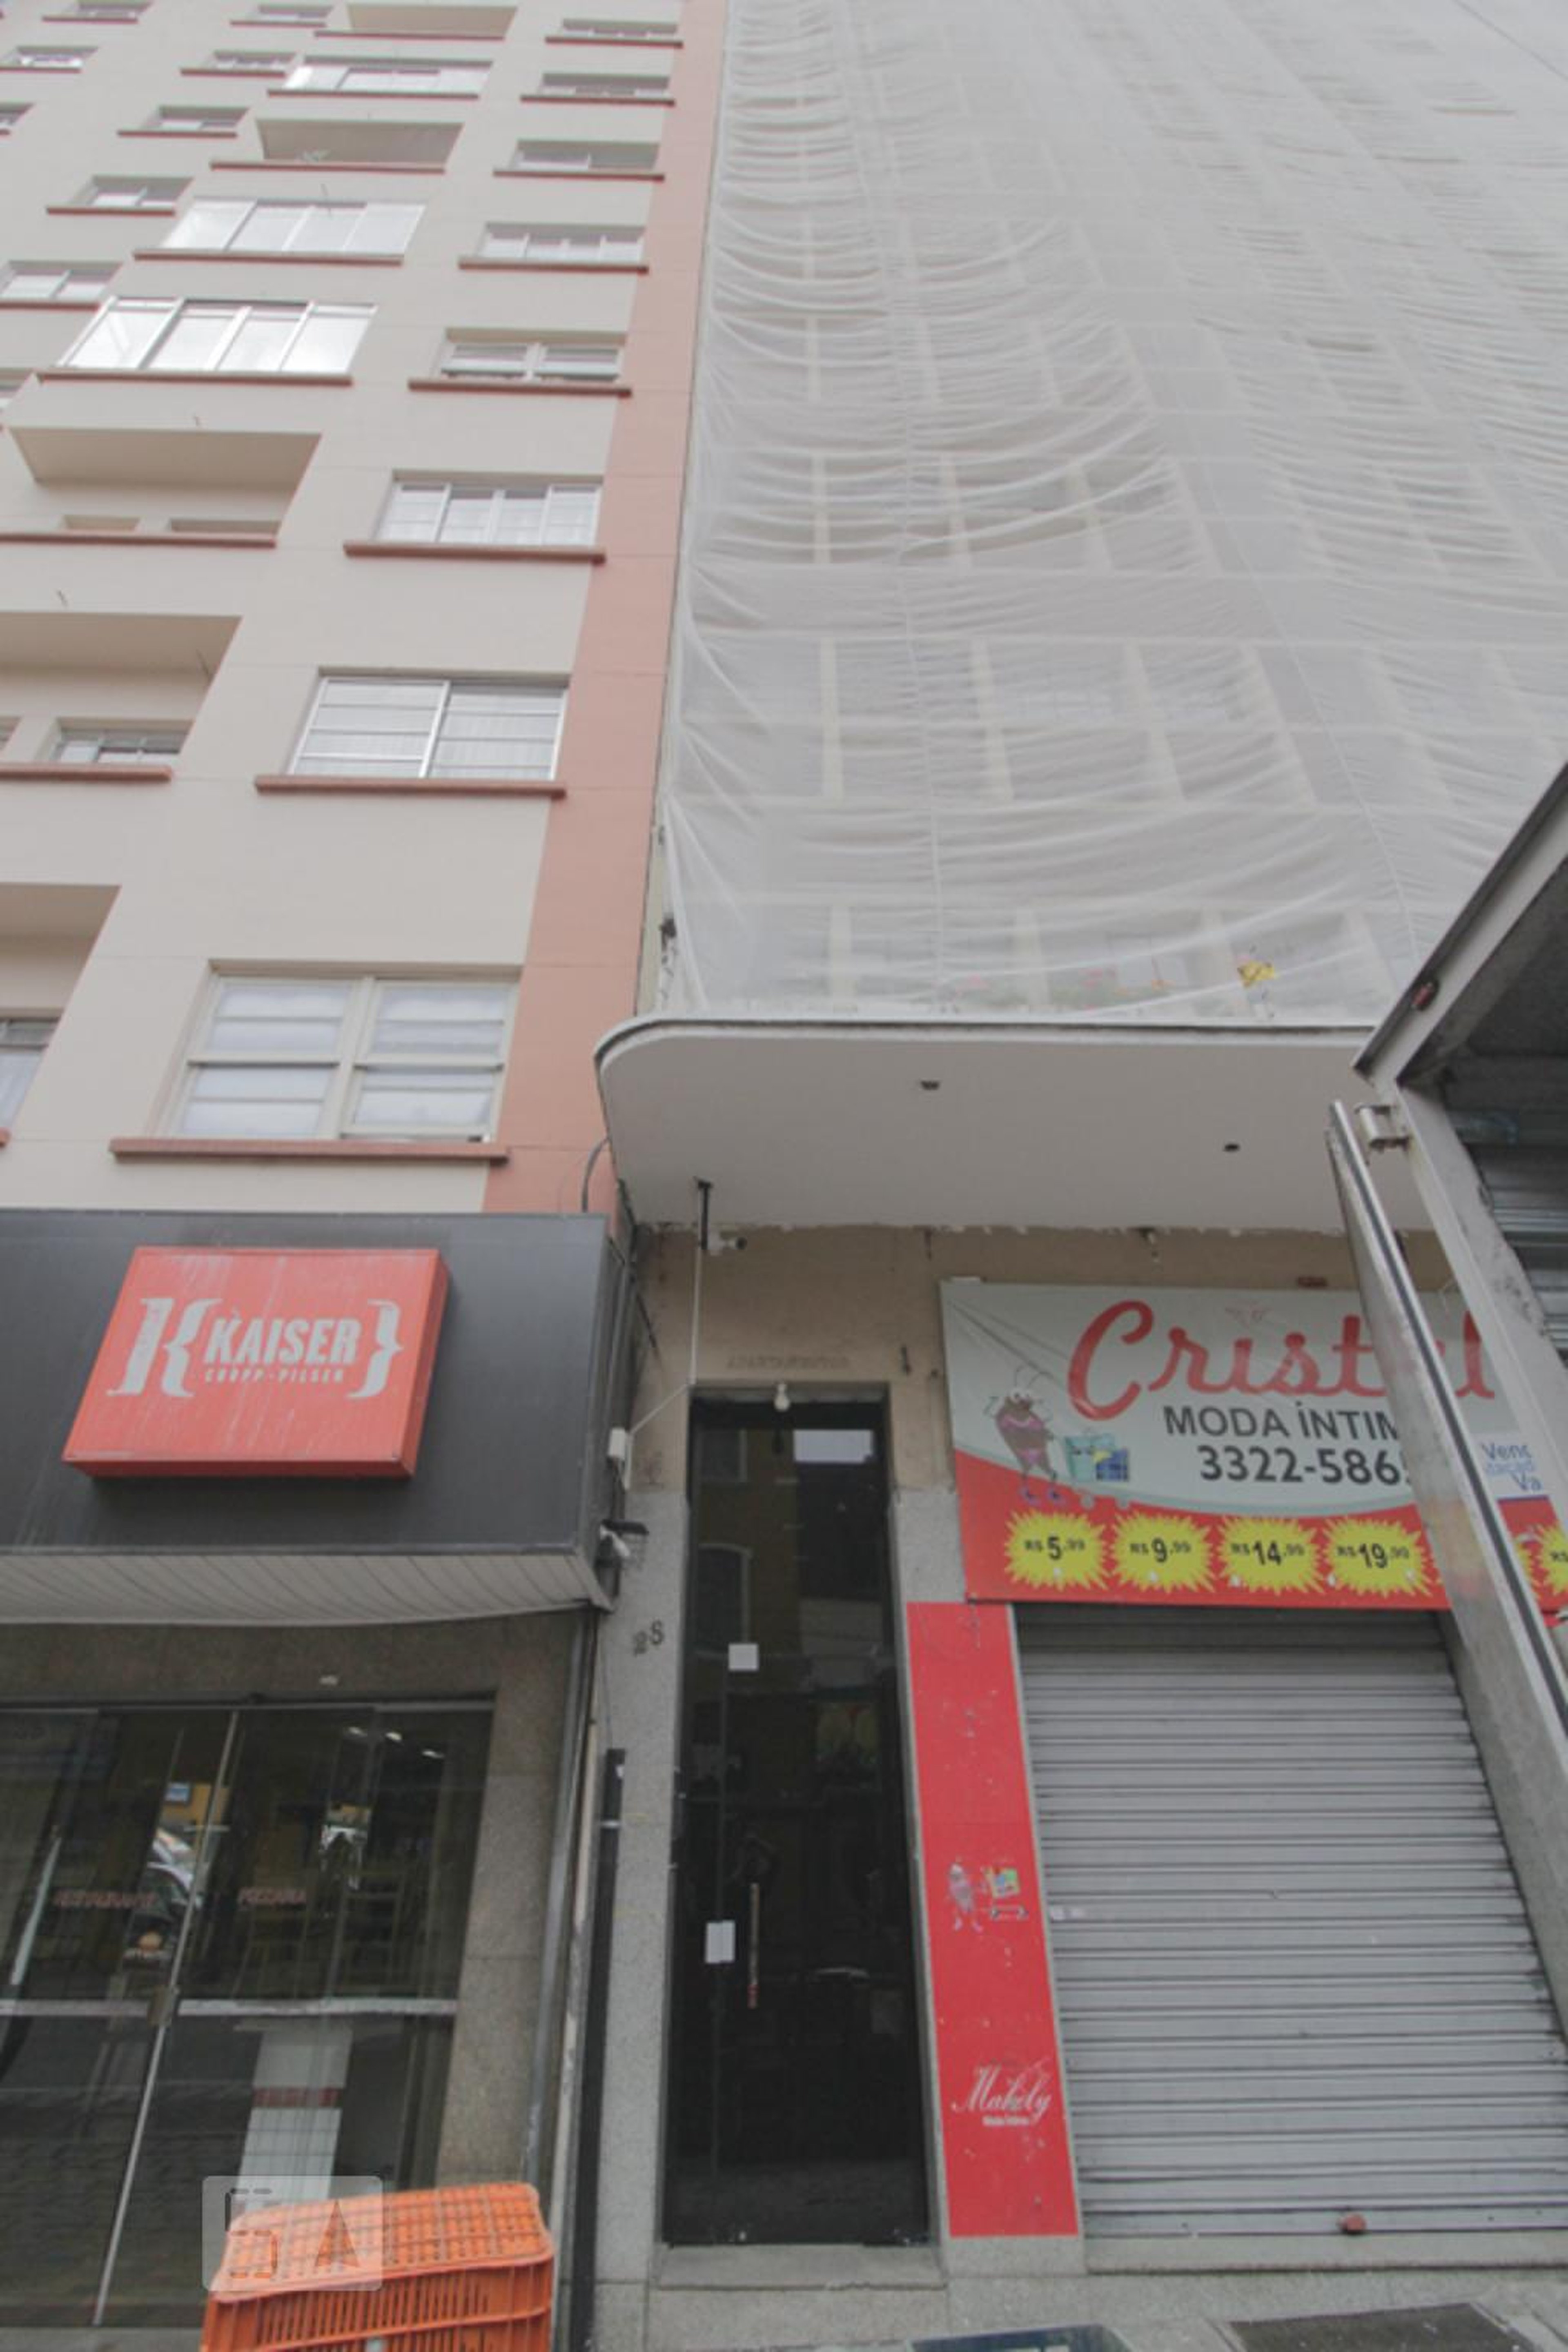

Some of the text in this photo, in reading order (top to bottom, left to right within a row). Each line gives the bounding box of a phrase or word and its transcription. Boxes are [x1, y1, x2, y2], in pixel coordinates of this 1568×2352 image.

[204, 1317, 361, 1365] KAISER
[1067, 1300, 1494, 1421] Cristl
[1163, 1401, 1398, 1440] MODA ÍNTIM
[1197, 1446, 1411, 1485] 3322-586
